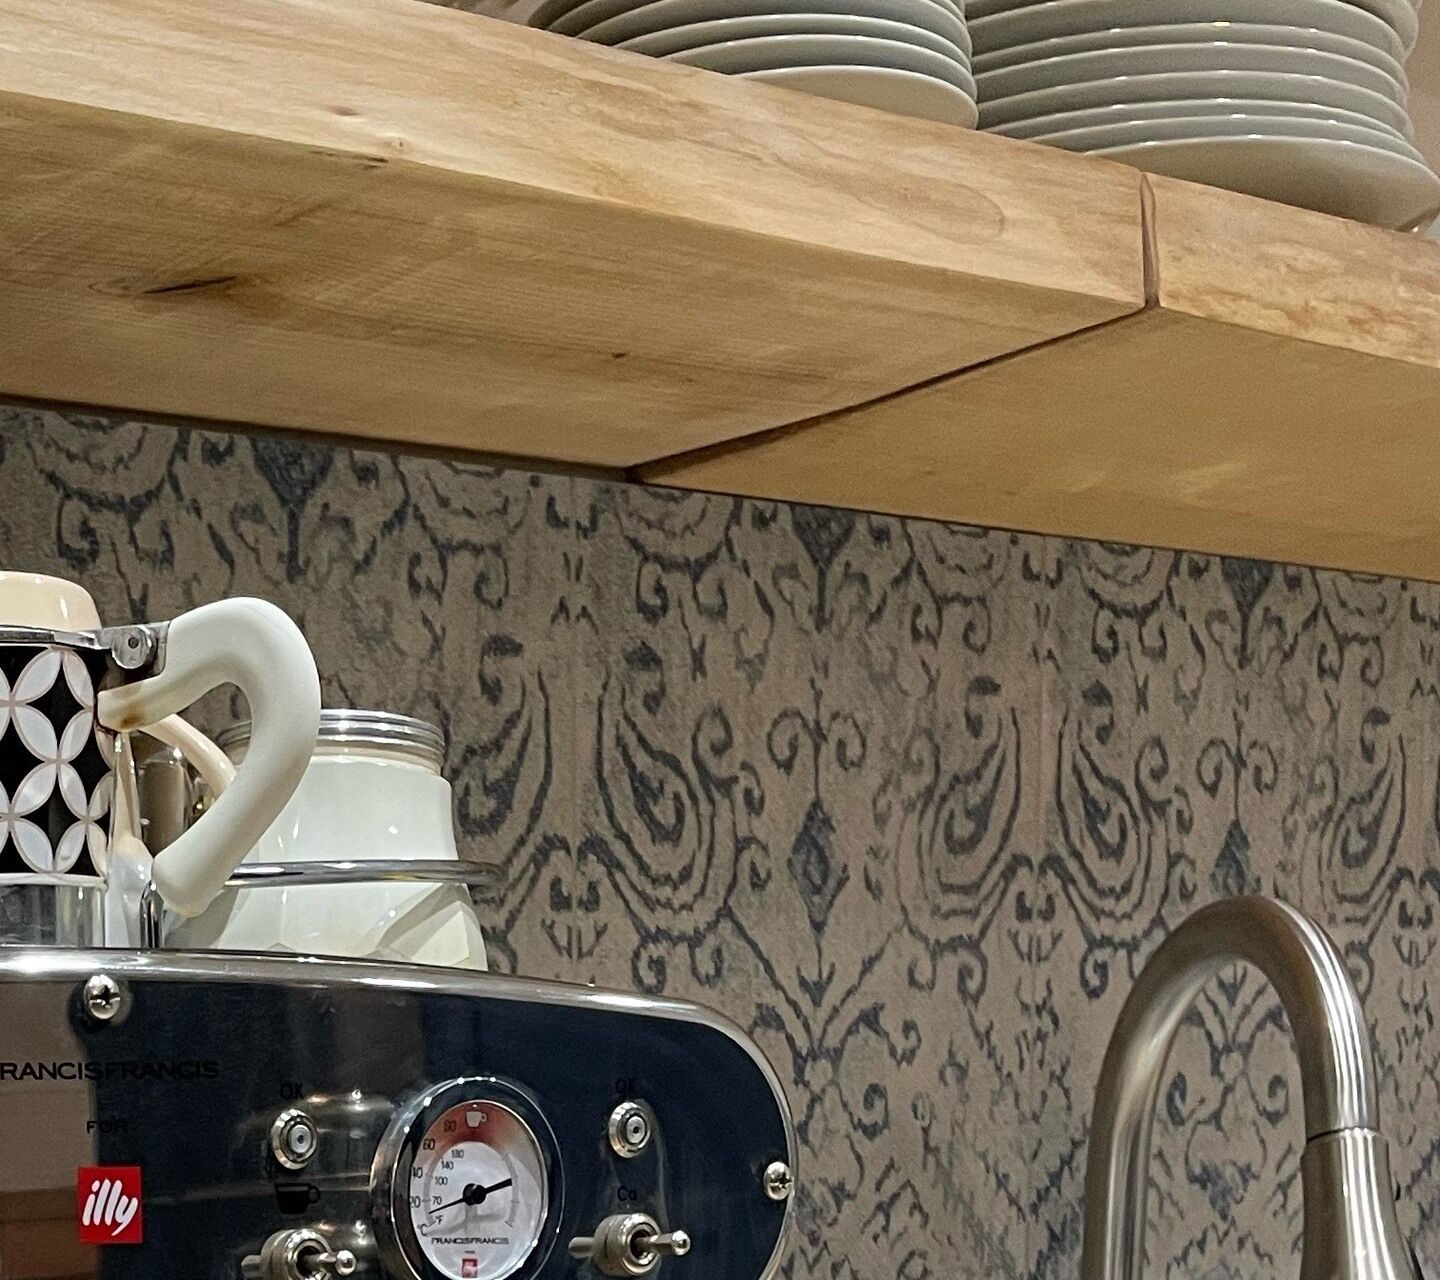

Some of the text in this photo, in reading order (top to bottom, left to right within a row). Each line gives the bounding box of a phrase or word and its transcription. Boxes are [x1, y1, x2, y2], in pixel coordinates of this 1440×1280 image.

[280, 1082, 305, 1100] OK
[86, 1118, 129, 1134] FOR
[423, 1138, 436, 1151] 60
[81, 1177, 139, 1236] illy
[432, 1196, 442, 1205] 70
